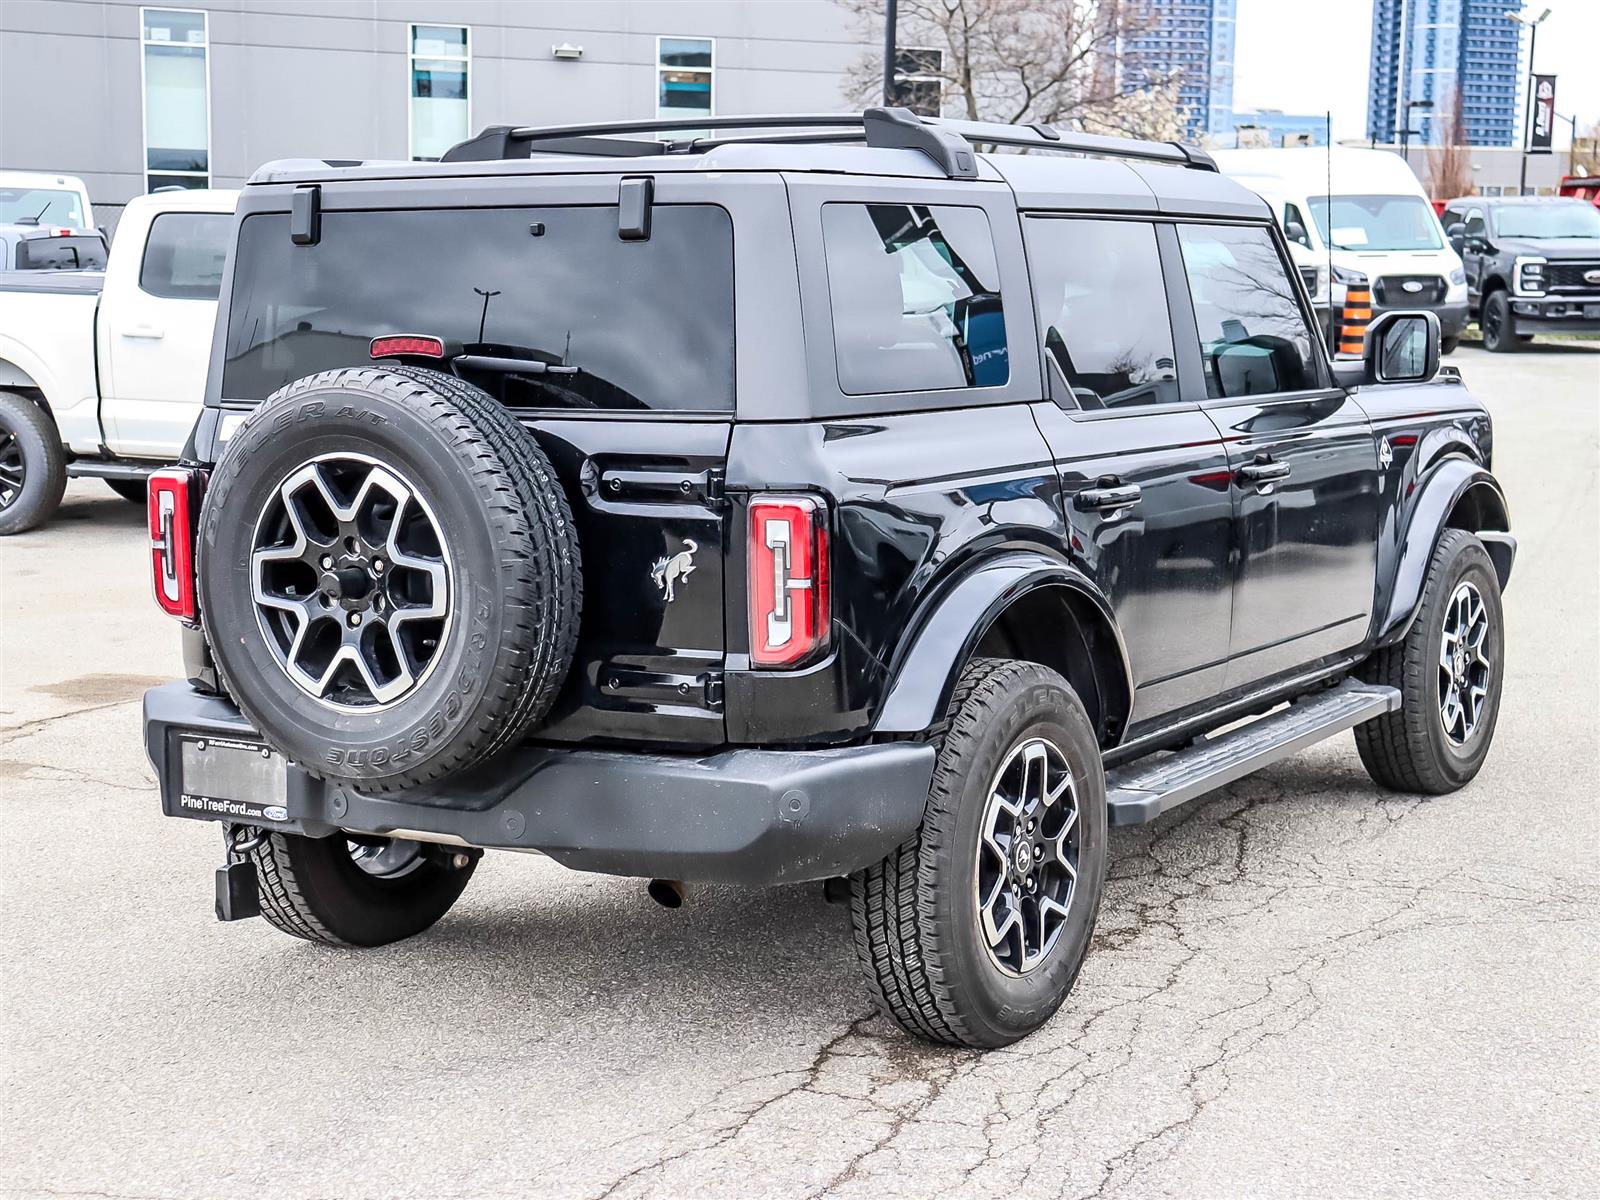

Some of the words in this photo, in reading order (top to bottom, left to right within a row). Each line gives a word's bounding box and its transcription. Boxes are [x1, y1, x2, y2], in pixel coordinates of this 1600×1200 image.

[206, 401, 326, 548] DUELER
[335, 405, 388, 426] A/T
[180, 795, 261, 817] PineTreeFord.com
